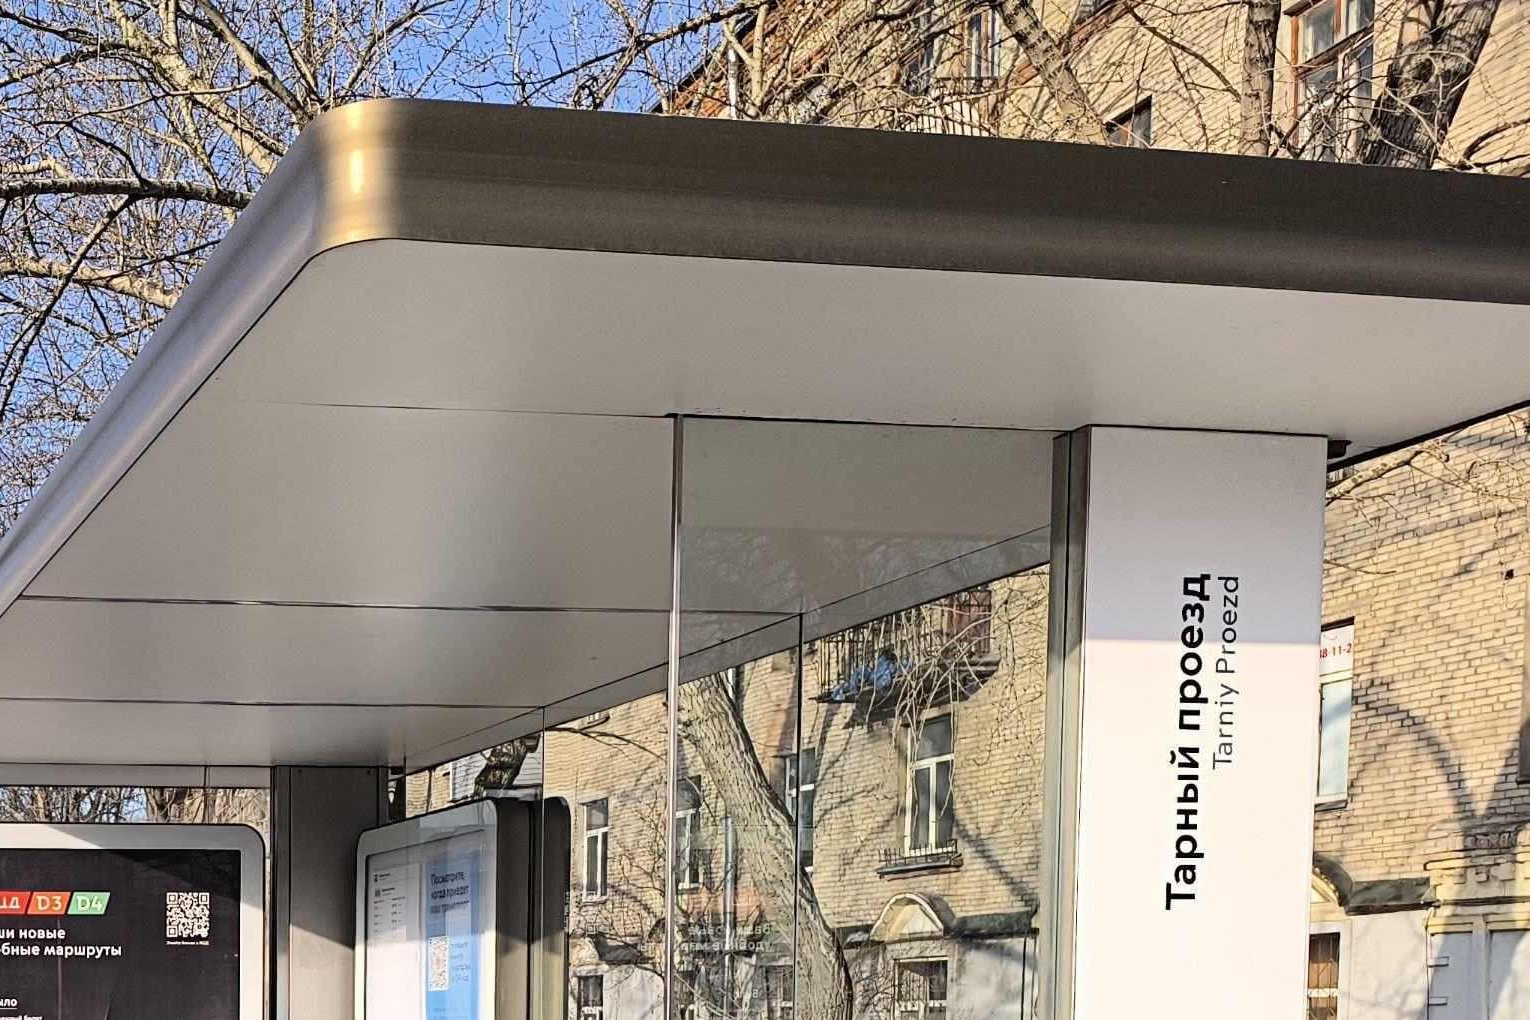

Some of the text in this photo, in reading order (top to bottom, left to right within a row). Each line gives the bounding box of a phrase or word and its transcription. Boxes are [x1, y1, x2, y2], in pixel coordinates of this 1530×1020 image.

[1212, 576, 1240, 770] Tarniy Proezd
[1165, 572, 1211, 911] Тарный проезд
[19, 928, 66, 939] новые
[44, 944, 122, 959] маршруты
